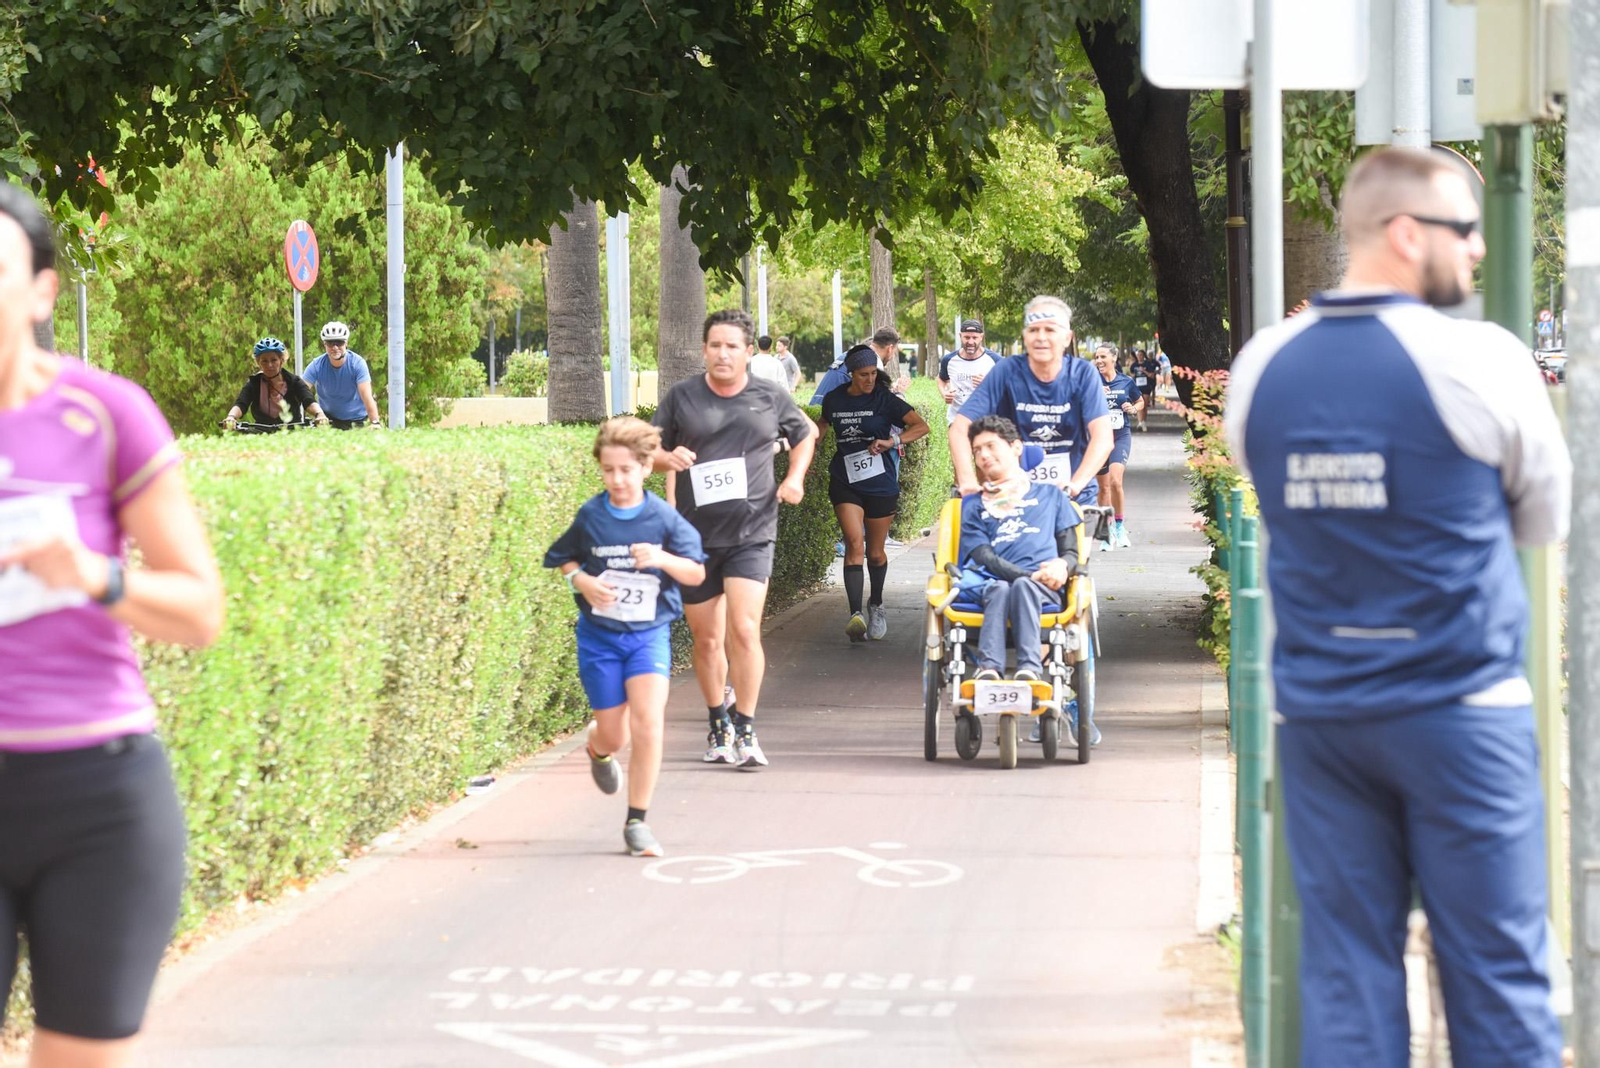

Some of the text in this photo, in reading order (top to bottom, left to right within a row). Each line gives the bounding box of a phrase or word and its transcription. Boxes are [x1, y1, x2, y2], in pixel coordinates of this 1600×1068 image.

[853, 456, 873, 472] 567
[1030, 465, 1059, 481] 336
[704, 471, 734, 490] 556
[612, 585, 645, 605] 23
[987, 691, 1019, 706] 339
[447, 966, 975, 992] PRIORIDAD
[428, 991, 958, 1017] PEATONAL
